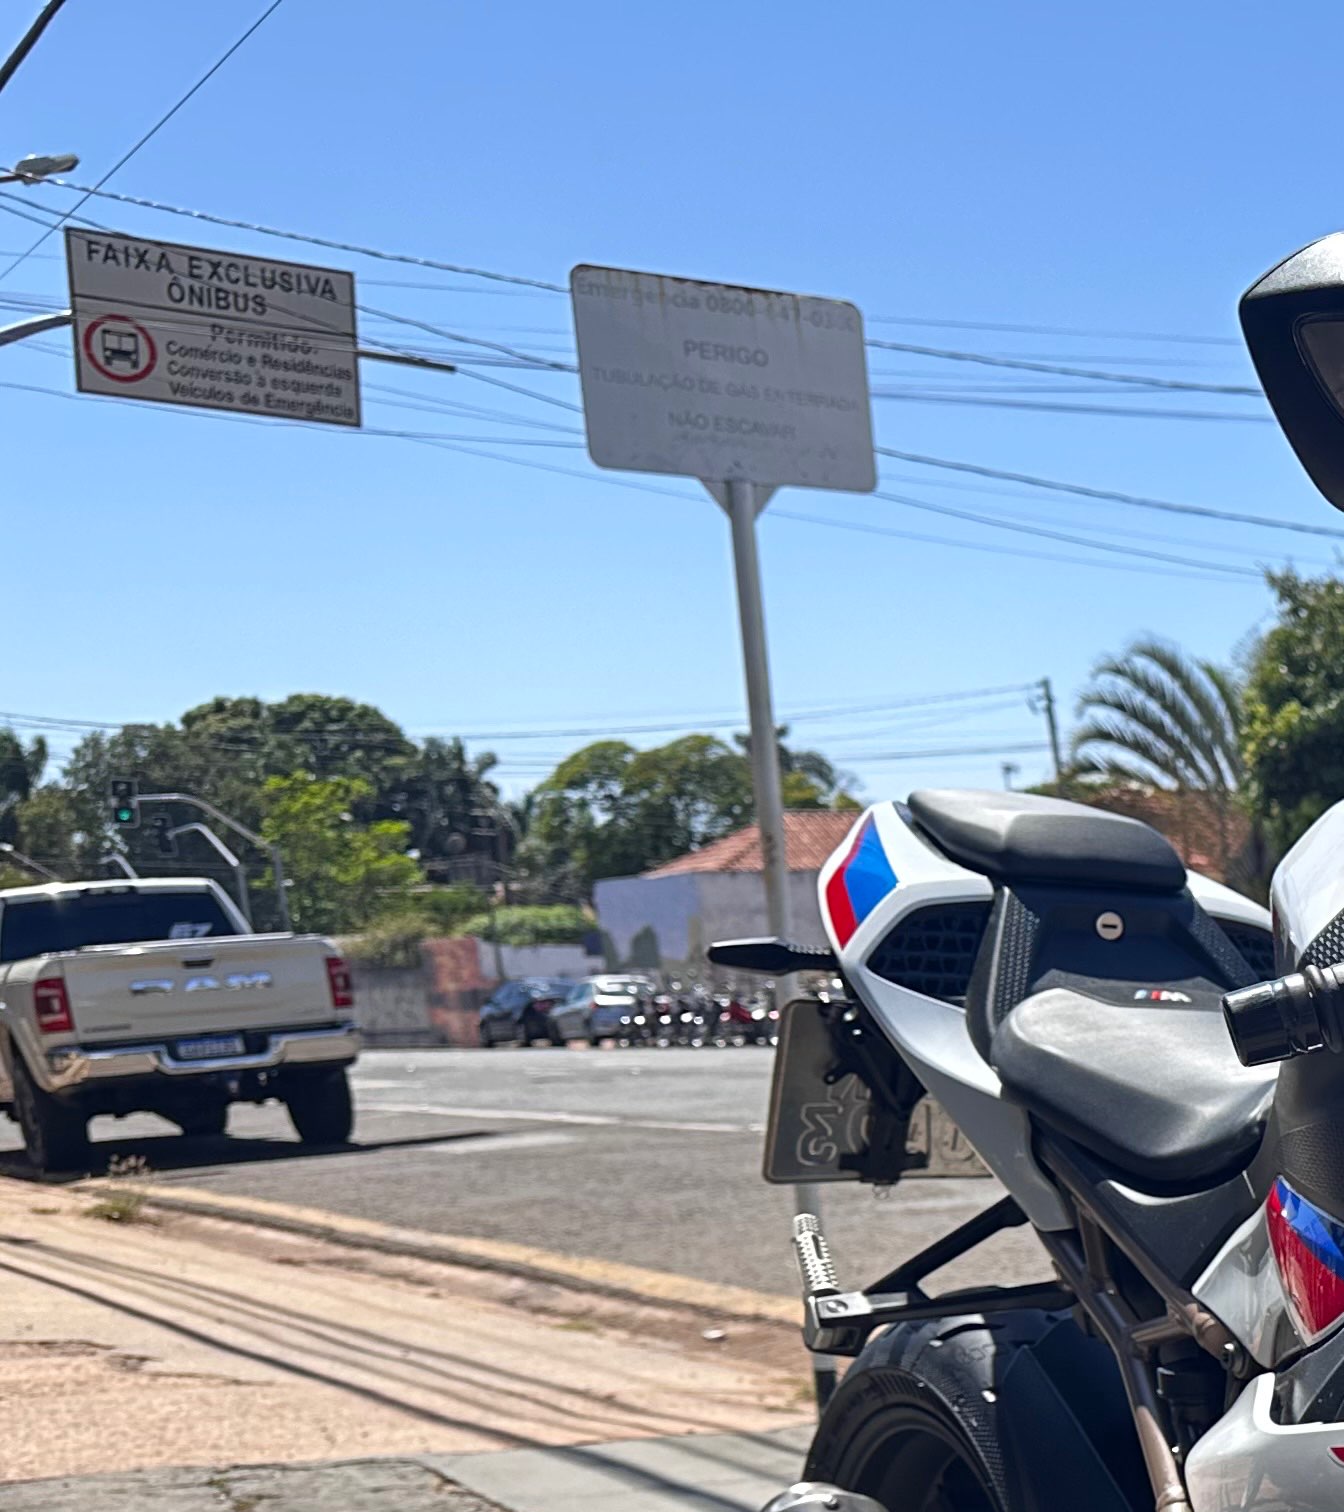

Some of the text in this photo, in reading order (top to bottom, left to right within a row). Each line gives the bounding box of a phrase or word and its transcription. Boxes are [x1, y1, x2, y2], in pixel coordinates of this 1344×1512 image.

[85, 240, 338, 300] FAIXA EXCLUSIVA
[166, 277, 268, 316] ÔNIBUS
[247, 356, 257, 368] e
[261, 353, 353, 381] Residências
[683, 339, 769, 367] PERIGO
[166, 361, 252, 386] Conversão
[270, 376, 343, 399] esquerda
[699, 378, 723, 395] DE
[239, 389, 260, 407] de
[668, 409, 709, 431] NÃO
[128, 971, 273, 996] RAM
